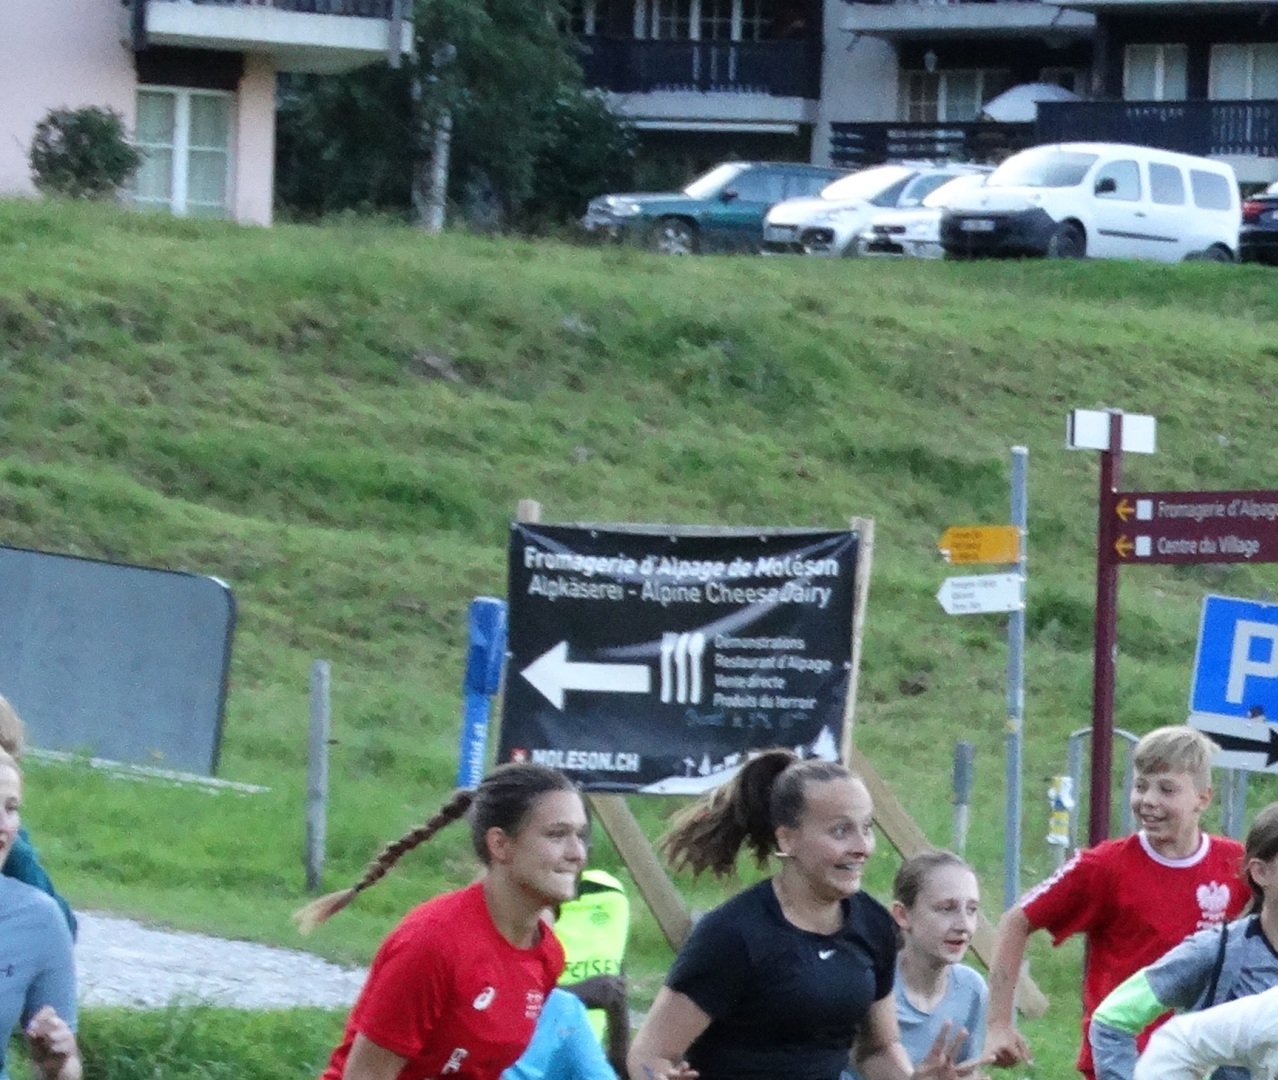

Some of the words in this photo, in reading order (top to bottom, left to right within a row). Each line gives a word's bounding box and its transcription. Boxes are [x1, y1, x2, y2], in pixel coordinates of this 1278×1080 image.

[1158, 500, 1226, 522] Fromagerie
[1157, 536, 1197, 554] Centre
[1199, 536, 1217, 554] du
[1218, 535, 1260, 558] Village
[524, 546, 637, 577] Fromagerie
[639, 555, 726, 581] d'Alpage
[727, 557, 753, 577] de
[528, 574, 625, 602] Alpkäserei
[641, 579, 700, 605] Alpine
[706, 582, 778, 604] Cheese
[779, 582, 832, 609] Dairy
[714, 653, 775, 669] Restaurant
[713, 693, 757, 708] Produits
[758, 694, 774, 708] du
[531, 748, 640, 772] MOLESON.CH
